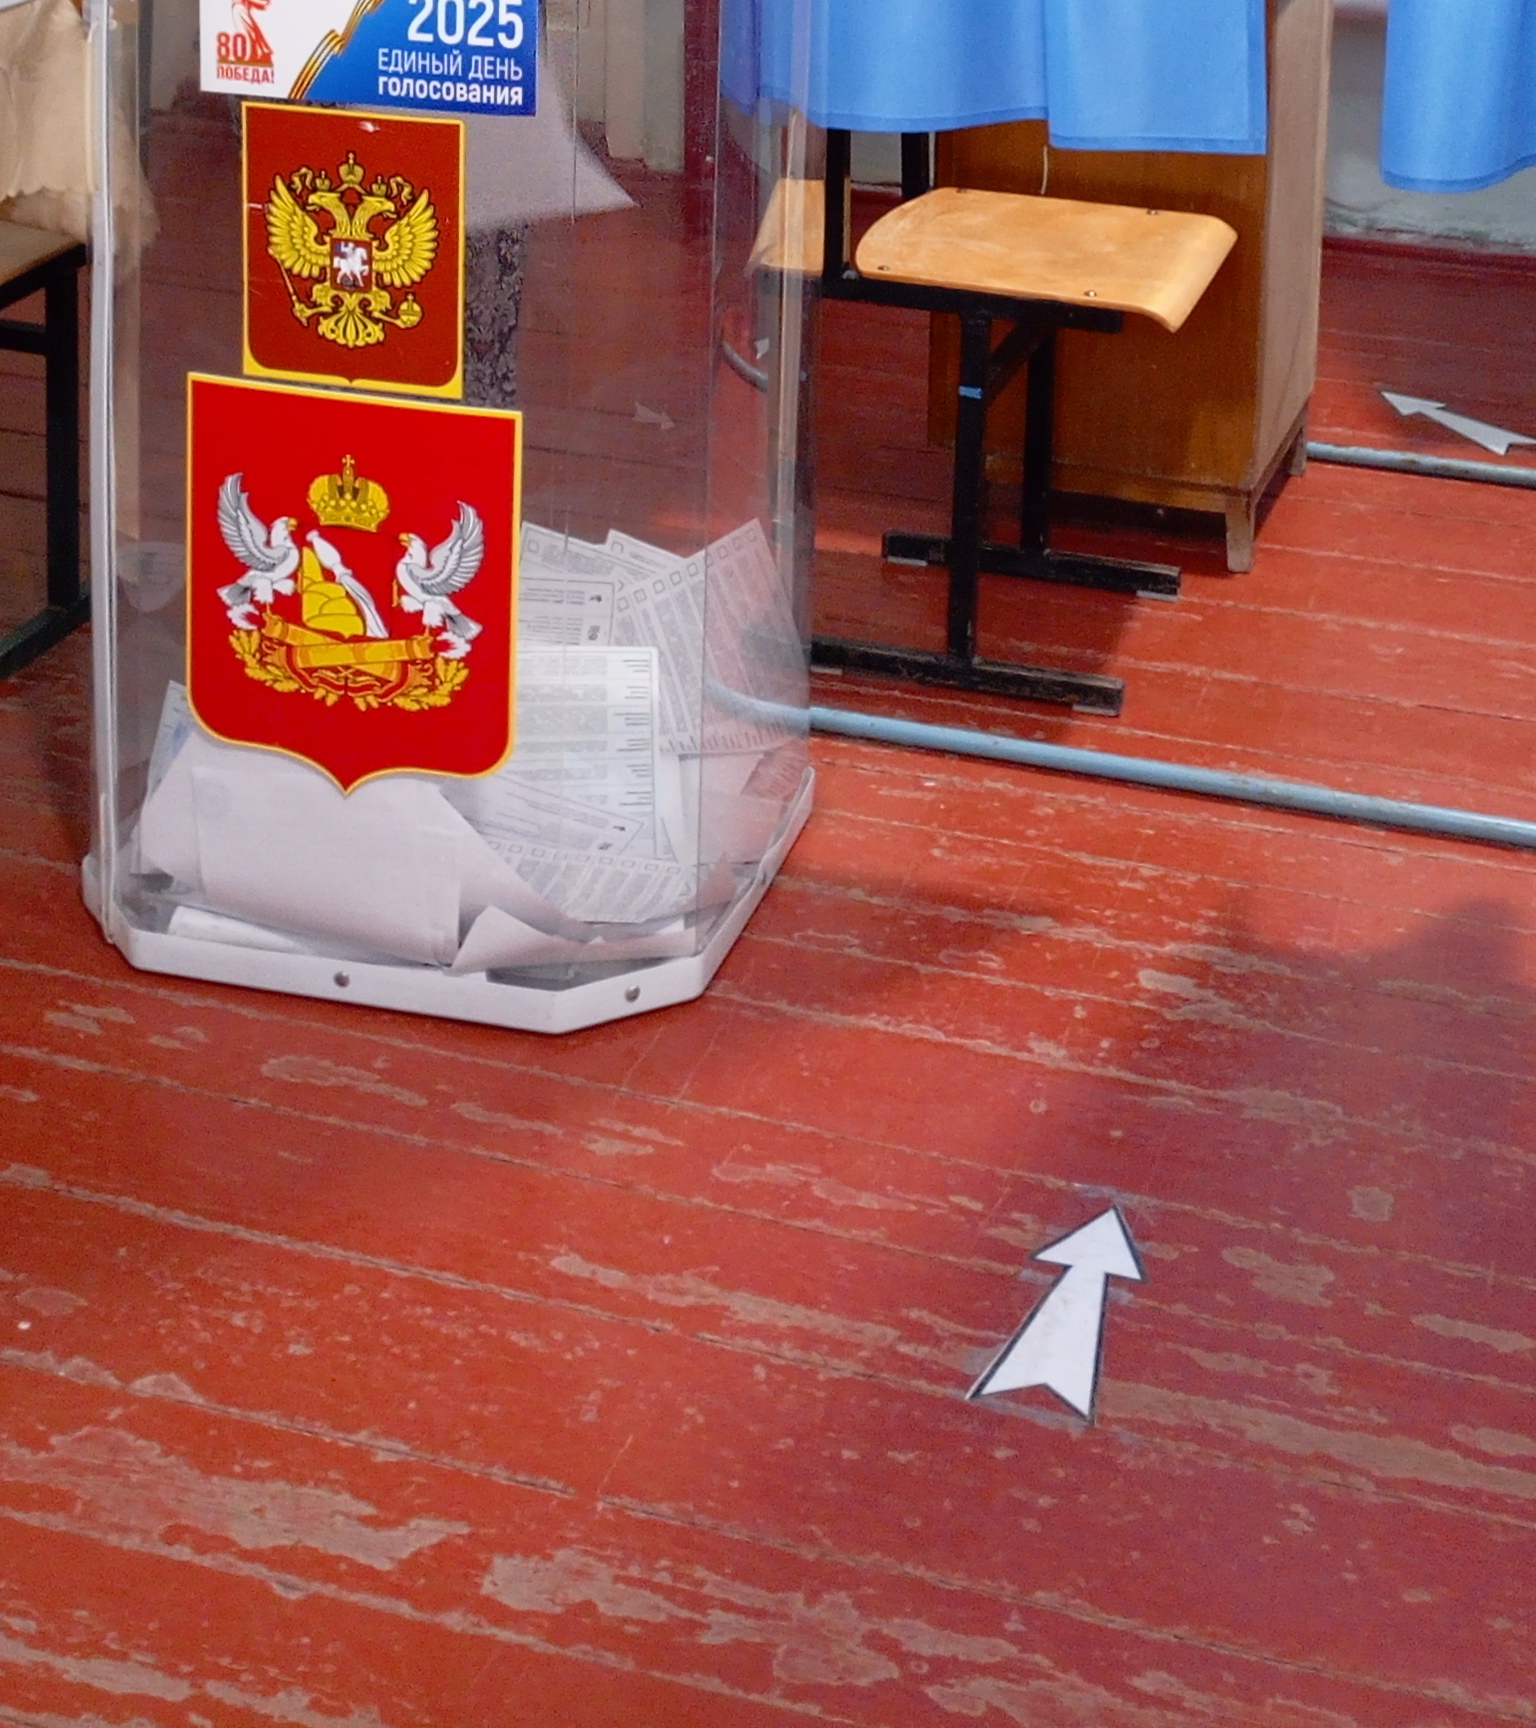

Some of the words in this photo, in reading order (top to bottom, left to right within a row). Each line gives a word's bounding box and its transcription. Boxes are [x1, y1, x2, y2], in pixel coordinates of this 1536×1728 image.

[217, 31, 247, 62] 80
[216, 65, 275, 85] ПОБЕДА!
[378, 47, 462, 77] ЕДИНЫЙ
[468, 55, 524, 81] ДЕНЬ
